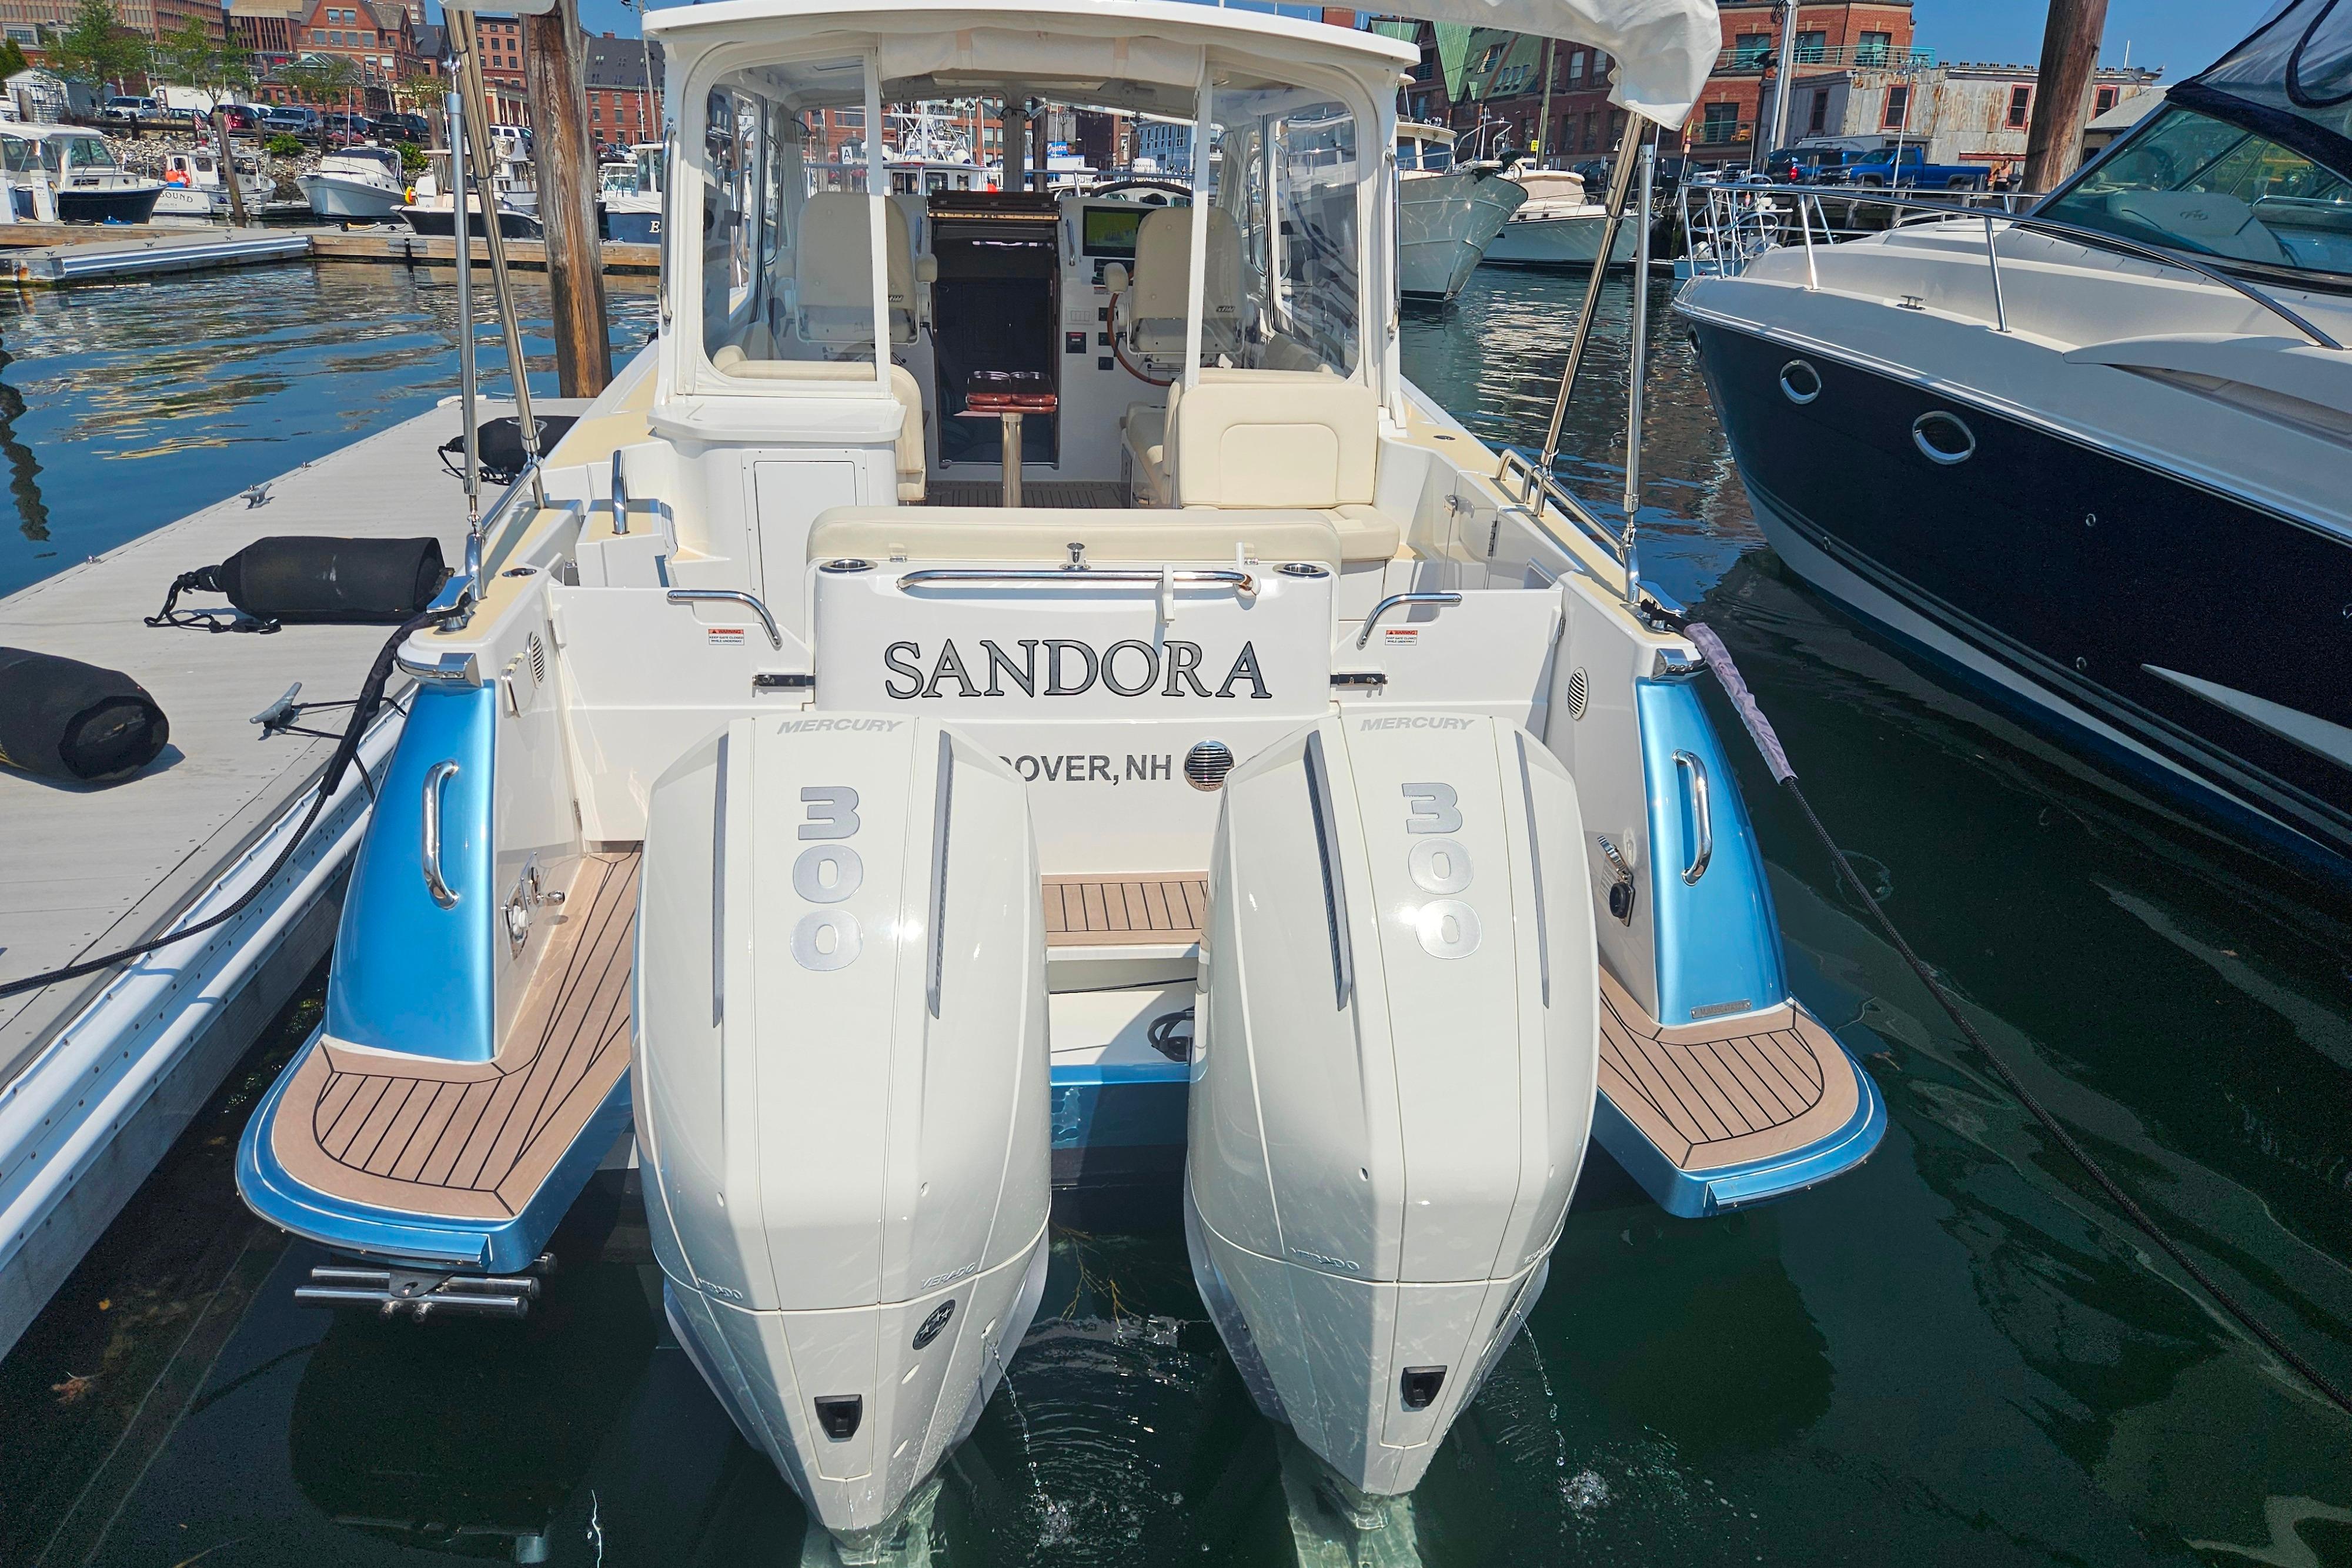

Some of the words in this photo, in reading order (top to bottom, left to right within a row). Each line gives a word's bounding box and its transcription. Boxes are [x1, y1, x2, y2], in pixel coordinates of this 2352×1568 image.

[844, 149, 851, 159] A
[884, 638, 1273, 700] SANDORA
[776, 718, 907, 735] MERCURY
[1359, 716, 1476, 732] MERCURY
[1125, 754, 1172, 781] NH
[790, 786, 864, 971] 300
[1401, 783, 1482, 959] 300
[920, 1262, 975, 1290] VERADO
